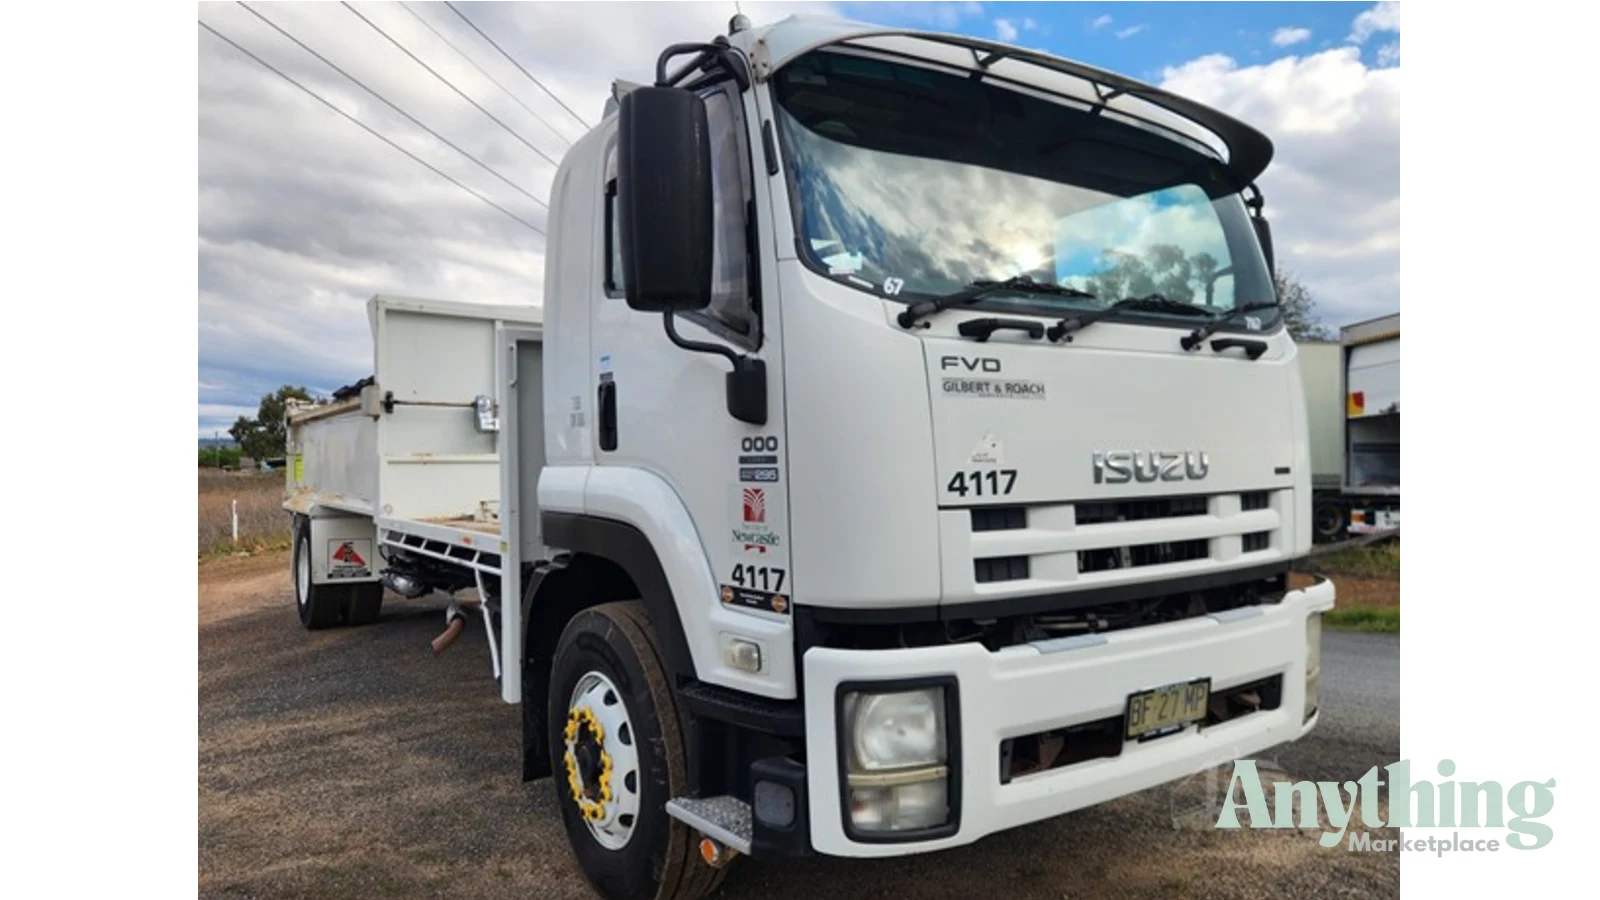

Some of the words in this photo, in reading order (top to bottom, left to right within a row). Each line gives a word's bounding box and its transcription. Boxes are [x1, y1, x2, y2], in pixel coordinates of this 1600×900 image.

[883, 277, 904, 295] 67
[941, 356, 1001, 372] FVD
[943, 380, 990, 393] GILBERT
[994, 384, 1002, 394] &
[1004, 382, 1045, 395] ROACH
[741, 436, 778, 452] 000
[1092, 450, 1209, 484] ISUZU
[947, 469, 1018, 497] 4117
[731, 563, 786, 593] 4117
[1130, 695, 1153, 728] BF
[1157, 690, 1179, 721] 27
